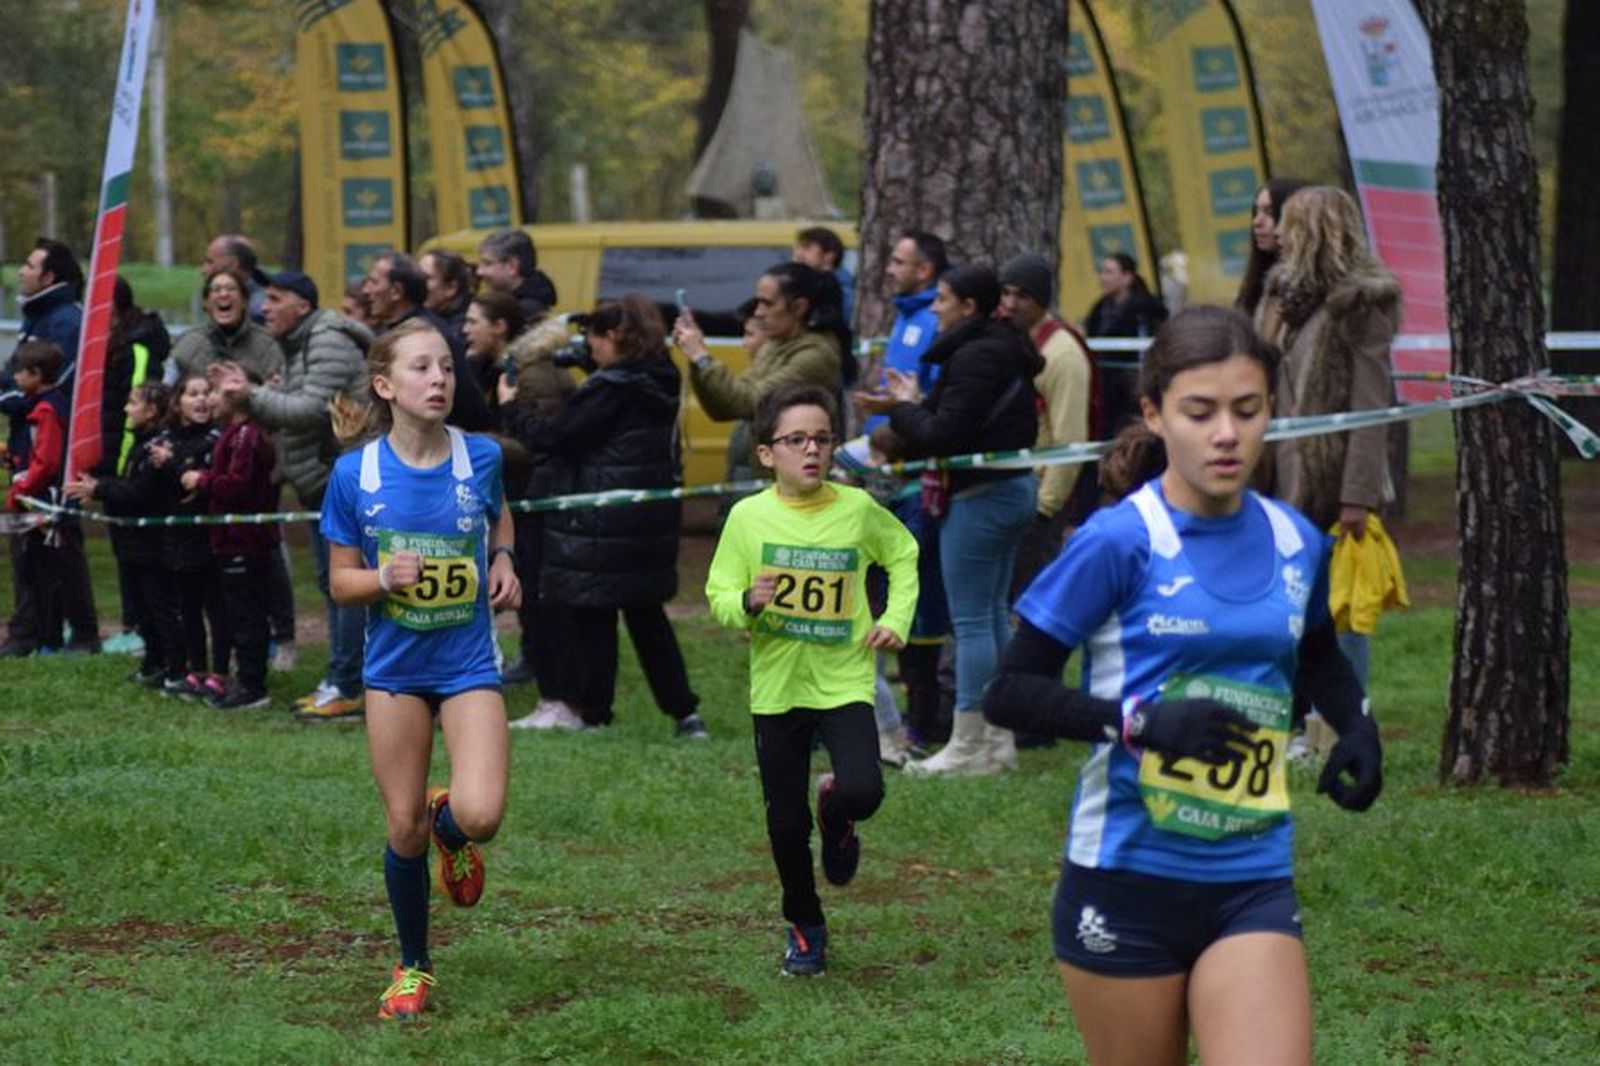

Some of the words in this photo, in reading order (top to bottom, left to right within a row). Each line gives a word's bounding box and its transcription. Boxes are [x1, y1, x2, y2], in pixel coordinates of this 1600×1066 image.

[396, 563, 468, 601] 55
[773, 572, 845, 614] 261
[1178, 804, 1221, 830] CAJA
